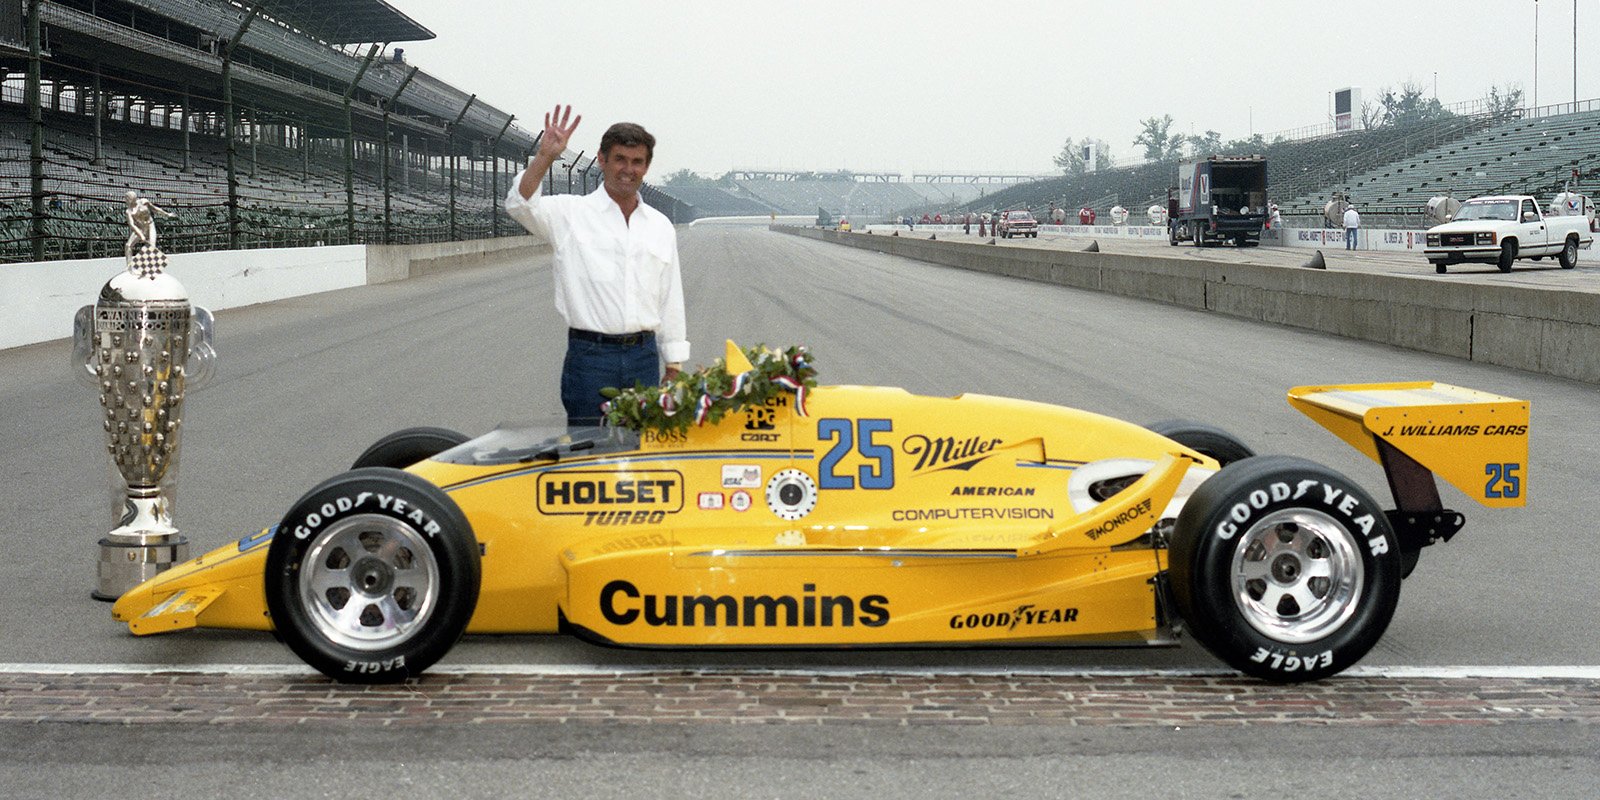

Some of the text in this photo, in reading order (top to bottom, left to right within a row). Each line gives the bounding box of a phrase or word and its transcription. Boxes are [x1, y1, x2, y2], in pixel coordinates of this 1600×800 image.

[645, 430, 688, 444] BOSS
[1382, 425, 1528, 437] J. WILLIAMS CARS
[817, 418, 895, 490] 25
[902, 434, 1003, 472] Miller
[546, 480, 675, 505] HOLSET
[951, 486, 1036, 497] AMERICAN
[1485, 463, 1520, 498] 25
[584, 510, 666, 527] TURBO
[892, 507, 1054, 521] COMPUTERVISION
[1095, 503, 1147, 539] MONROE
[600, 579, 890, 627] Cummins
[344, 655, 405, 674] EAGLE
[1250, 647, 1333, 671] EAGLE
